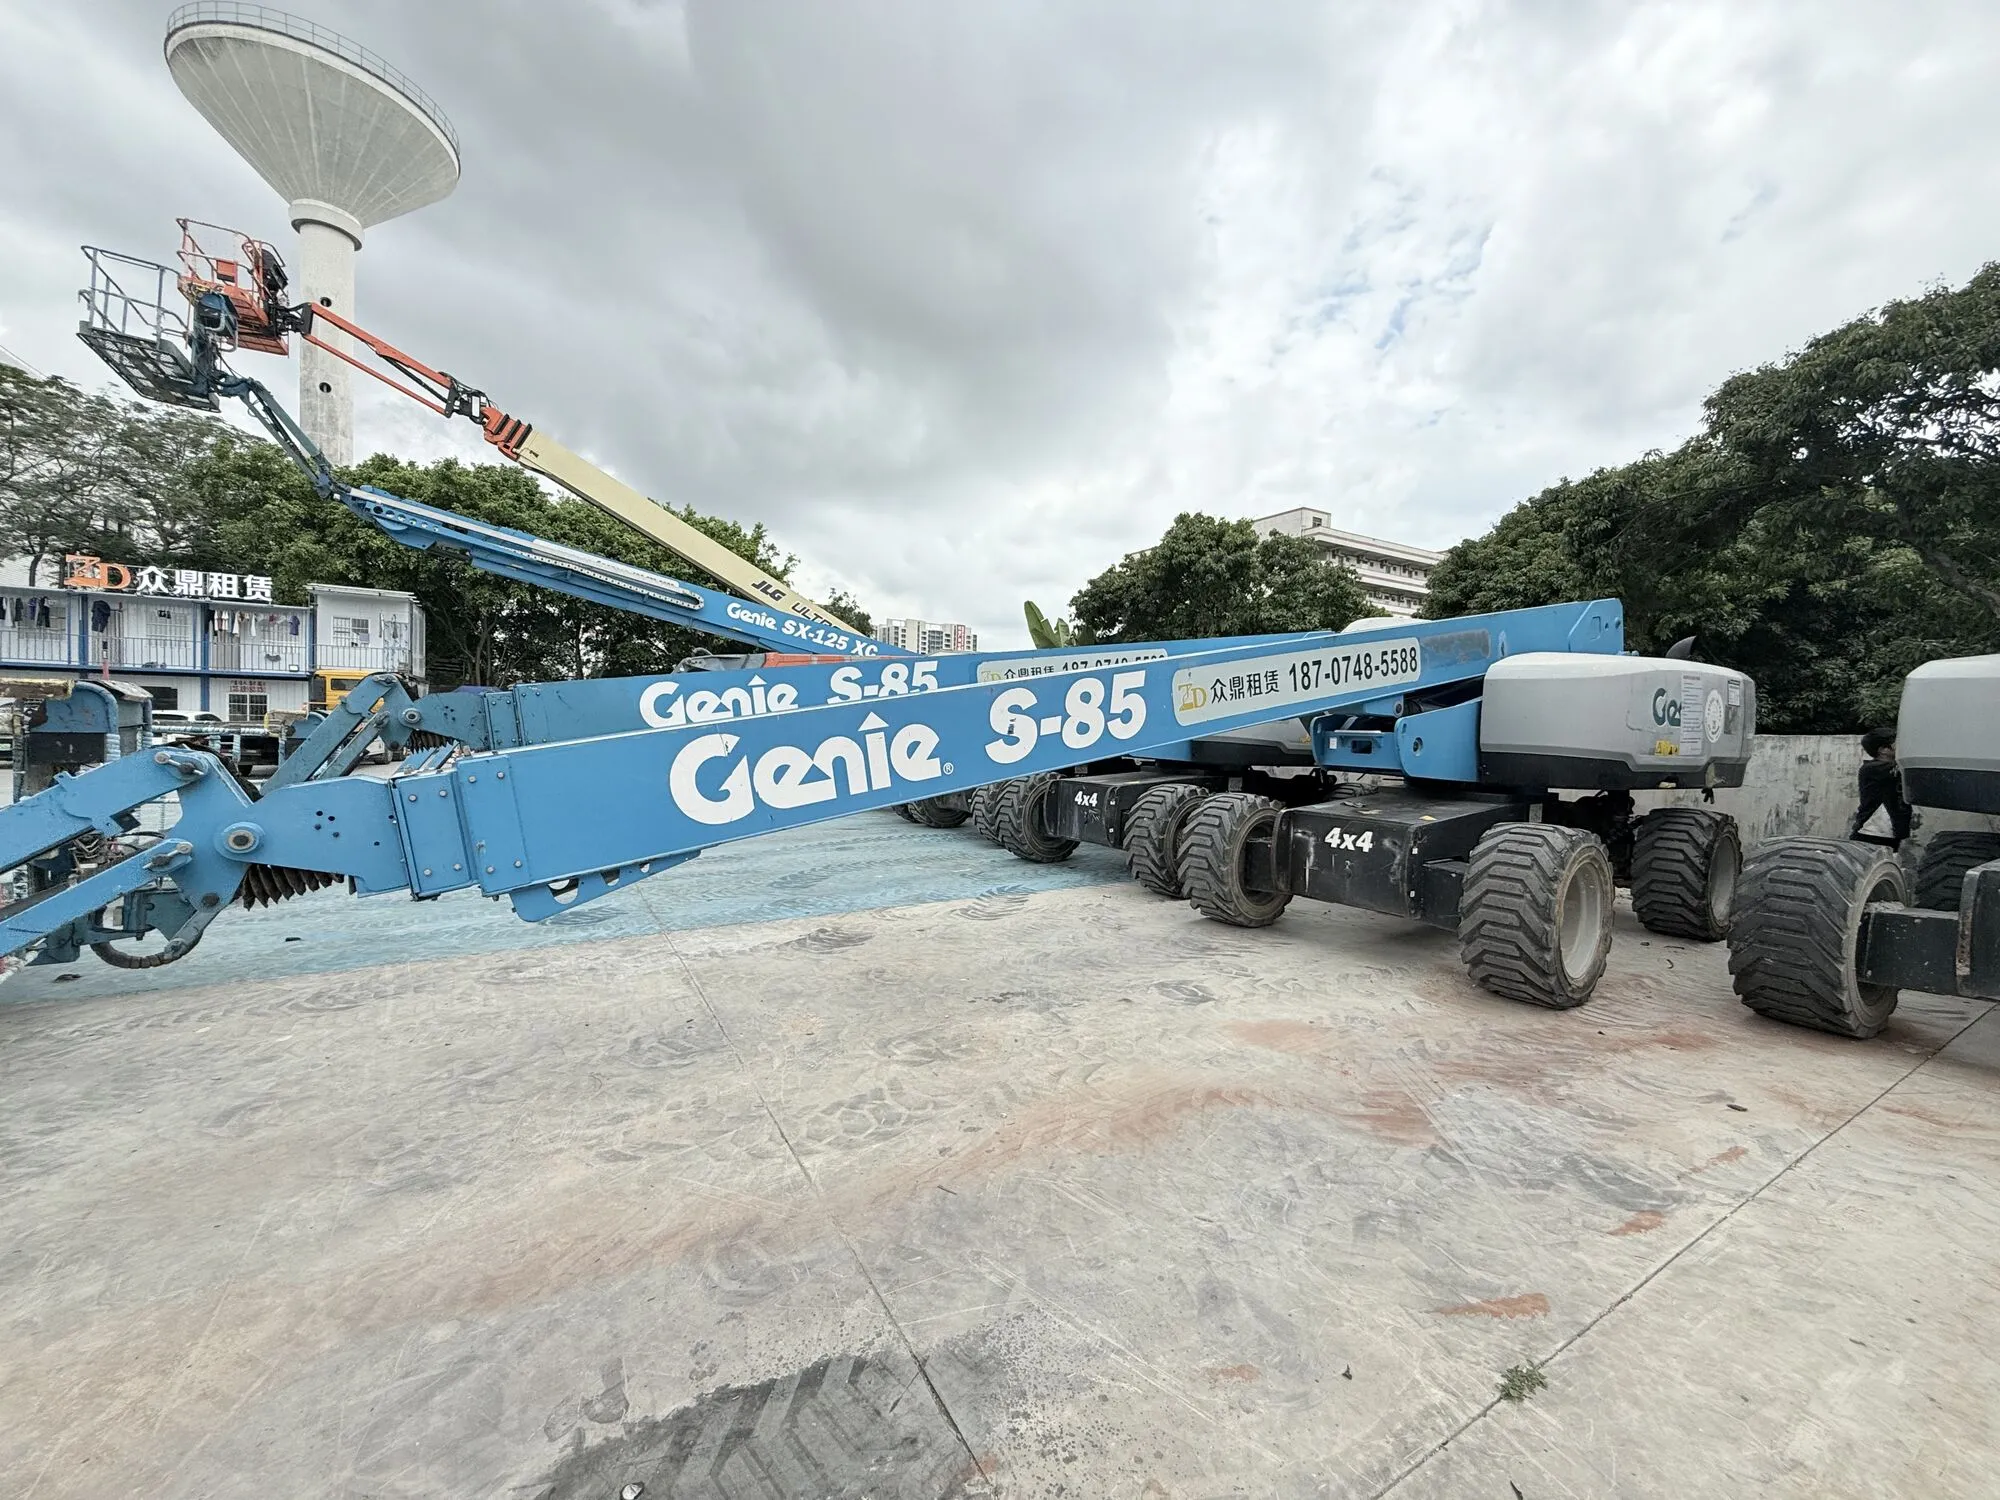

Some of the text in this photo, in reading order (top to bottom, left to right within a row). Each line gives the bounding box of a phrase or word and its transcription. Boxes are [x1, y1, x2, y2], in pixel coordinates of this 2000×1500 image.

[136, 566, 273, 601] 众鼎租赁
[751, 580, 787, 601] JLG
[726, 602, 879, 656] Genie SX-125 XC
[639, 660, 938, 728] Genie S-85
[1210, 669, 1280, 704] 众鼎租赁
[1289, 646, 1418, 692] 187-0748-5588
[984, 670, 1147, 764] S-85
[1074, 790, 1098, 807] 4x4
[1323, 827, 1374, 853] 4x4
